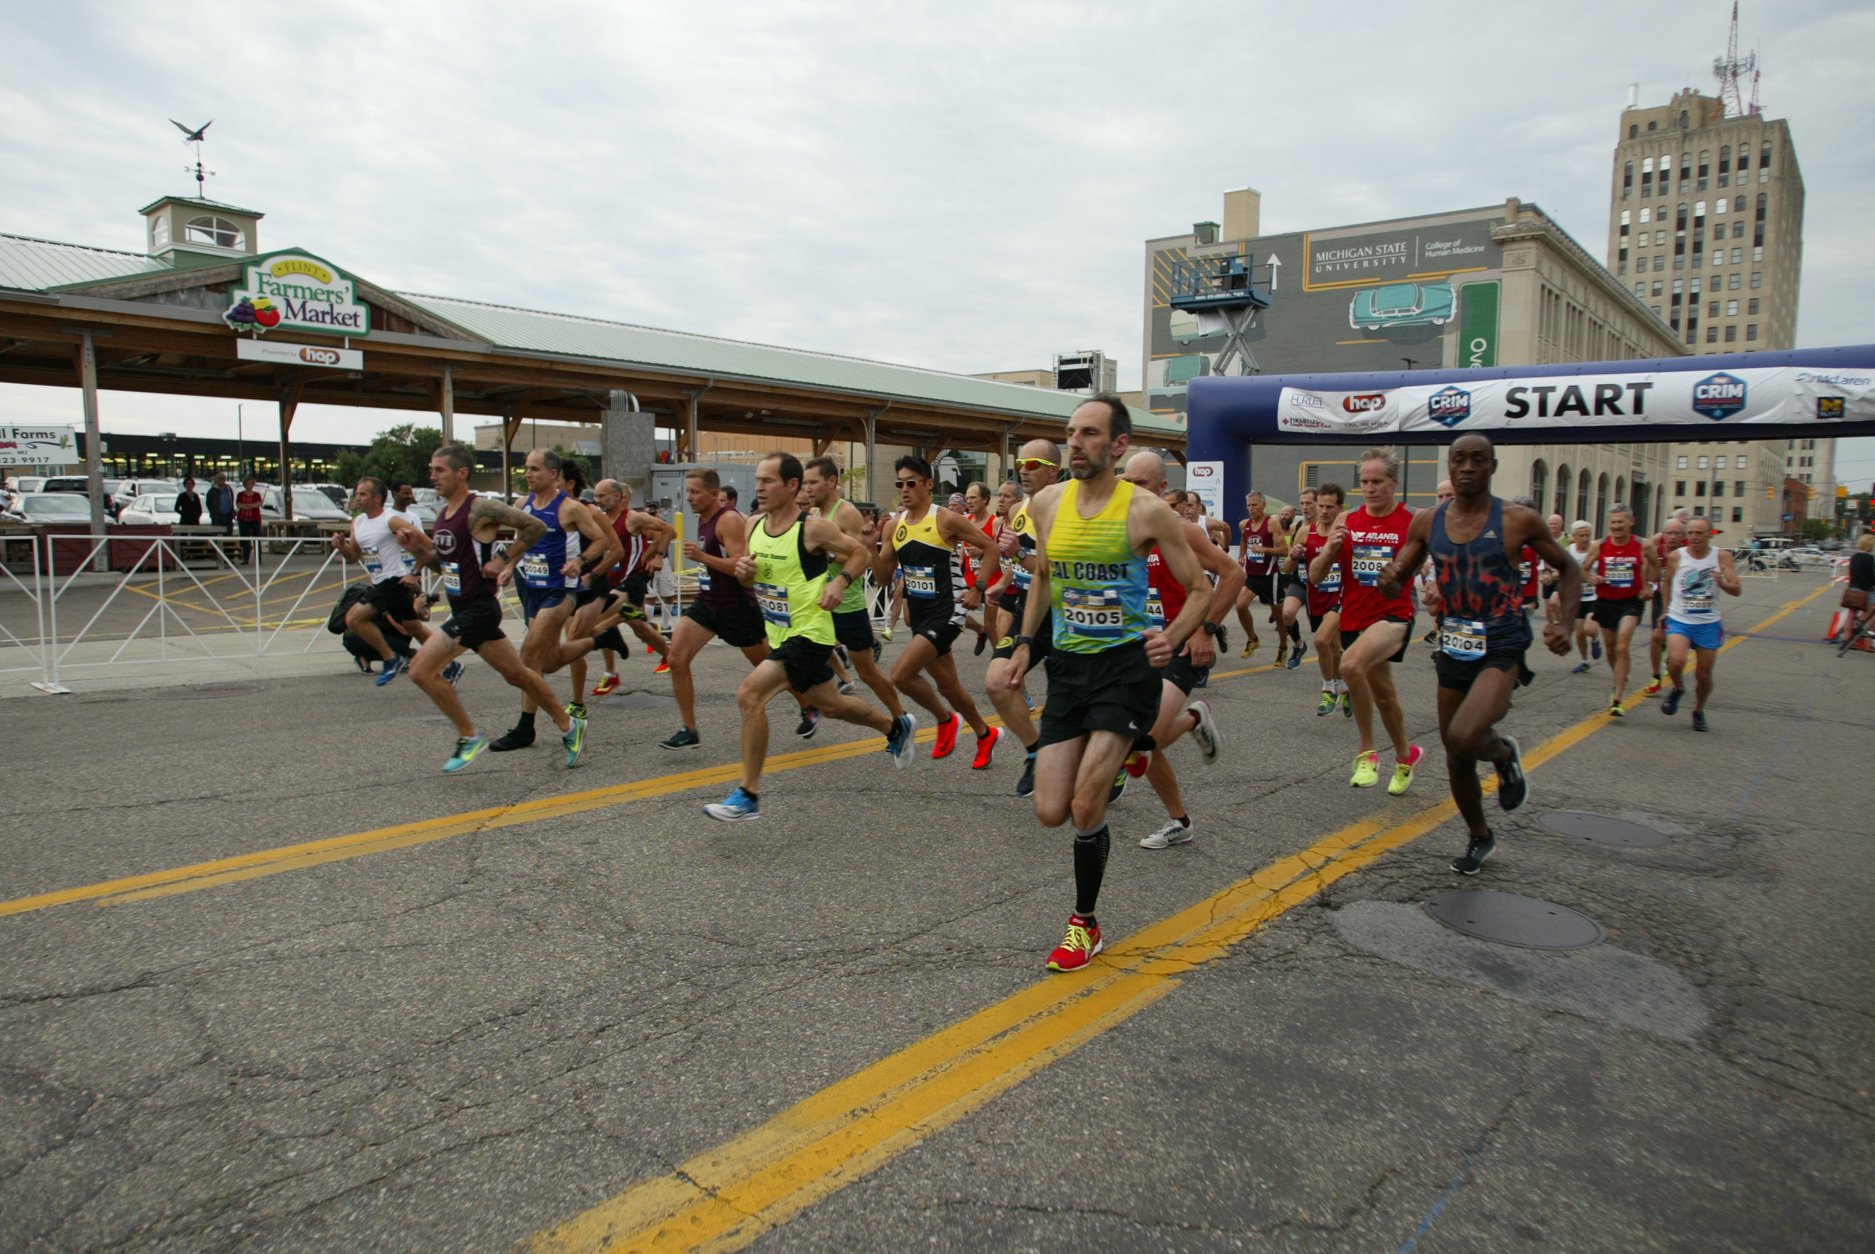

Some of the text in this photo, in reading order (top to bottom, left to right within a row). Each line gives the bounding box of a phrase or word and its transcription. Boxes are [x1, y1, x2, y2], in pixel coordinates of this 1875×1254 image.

[1425, 238, 1462, 250] College of
[1425, 245, 1485, 258] Human Medicine
[1315, 241, 1408, 263] MICHIGAN STATE
[285, 262, 320, 276] FLINT
[1315, 256, 1408, 273] UNIVERSITY
[255, 271, 350, 305] Farmers'
[283, 298, 361, 328] Market
[306, 347, 336, 365] hap
[1816, 375, 1872, 386] McLaren
[1696, 384, 1744, 399] CRIM
[1349, 396, 1382, 412] hap
[1431, 395, 1469, 409] CRIM
[1504, 382, 1654, 419] START
[12, 428, 56, 439] Farms
[1366, 532, 1399, 540] ATLANTA
[1074, 562, 1129, 580] COAST
[1353, 561, 1384, 571] 2008
[907, 579, 934, 591] 20101
[1065, 608, 1120, 625] 20105
[1444, 634, 1484, 651] 20104
